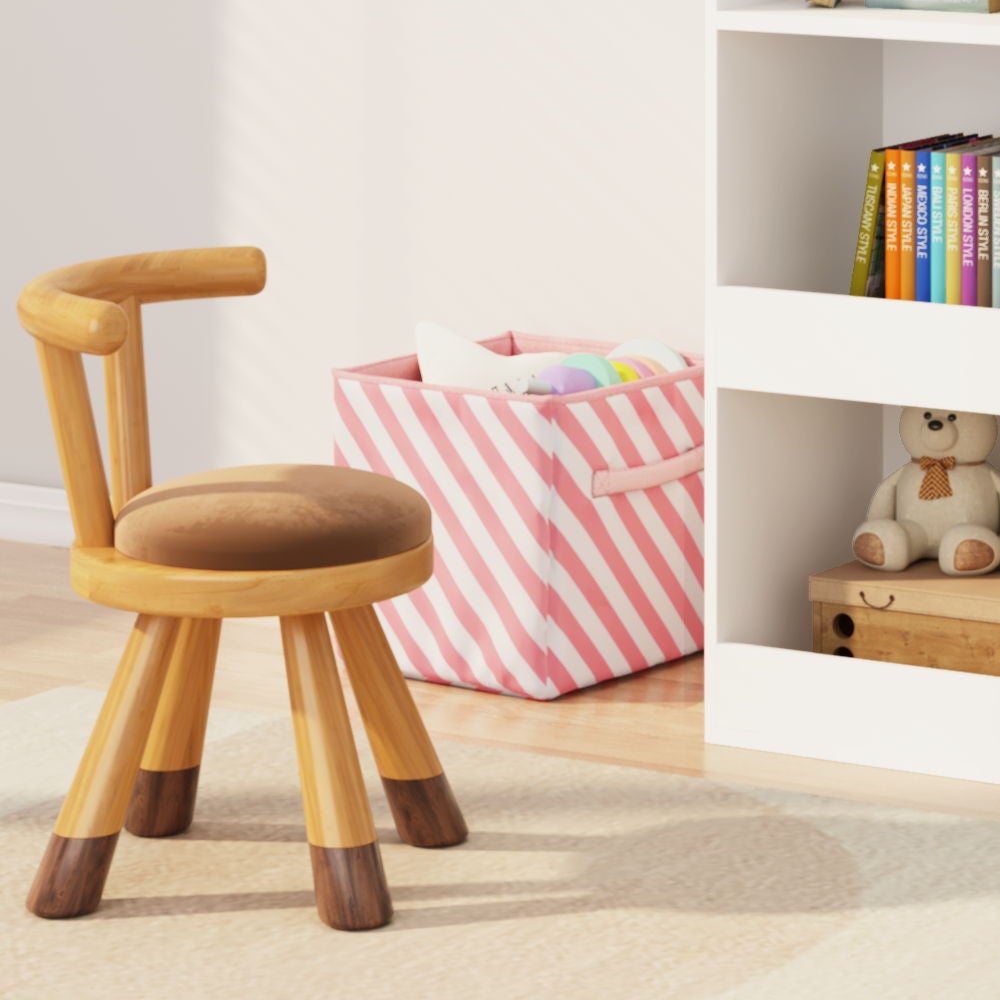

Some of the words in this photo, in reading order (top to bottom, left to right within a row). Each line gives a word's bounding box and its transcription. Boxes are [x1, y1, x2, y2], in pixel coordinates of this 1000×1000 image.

[861, 185, 878, 231] TUSCANY
[886, 183, 896, 218] INDIAN
[902, 183, 912, 218] JAPAN
[917, 185, 927, 224] MEXICO
[932, 186, 943, 209] BALI
[948, 187, 958, 218] PARIS
[962, 188, 973, 233] LONDON
[978, 189, 988, 226] BERLIN
[887, 220, 897, 252] STYLE
[902, 220, 912, 252] STYLE
[917, 227, 927, 259] STYLE
[932, 211, 943, 243] STYLE
[948, 220, 958, 252] STYLE
[856, 232, 870, 264] STYLE
[963, 235, 973, 266] STYLE
[978, 228, 988, 260] STYLE
